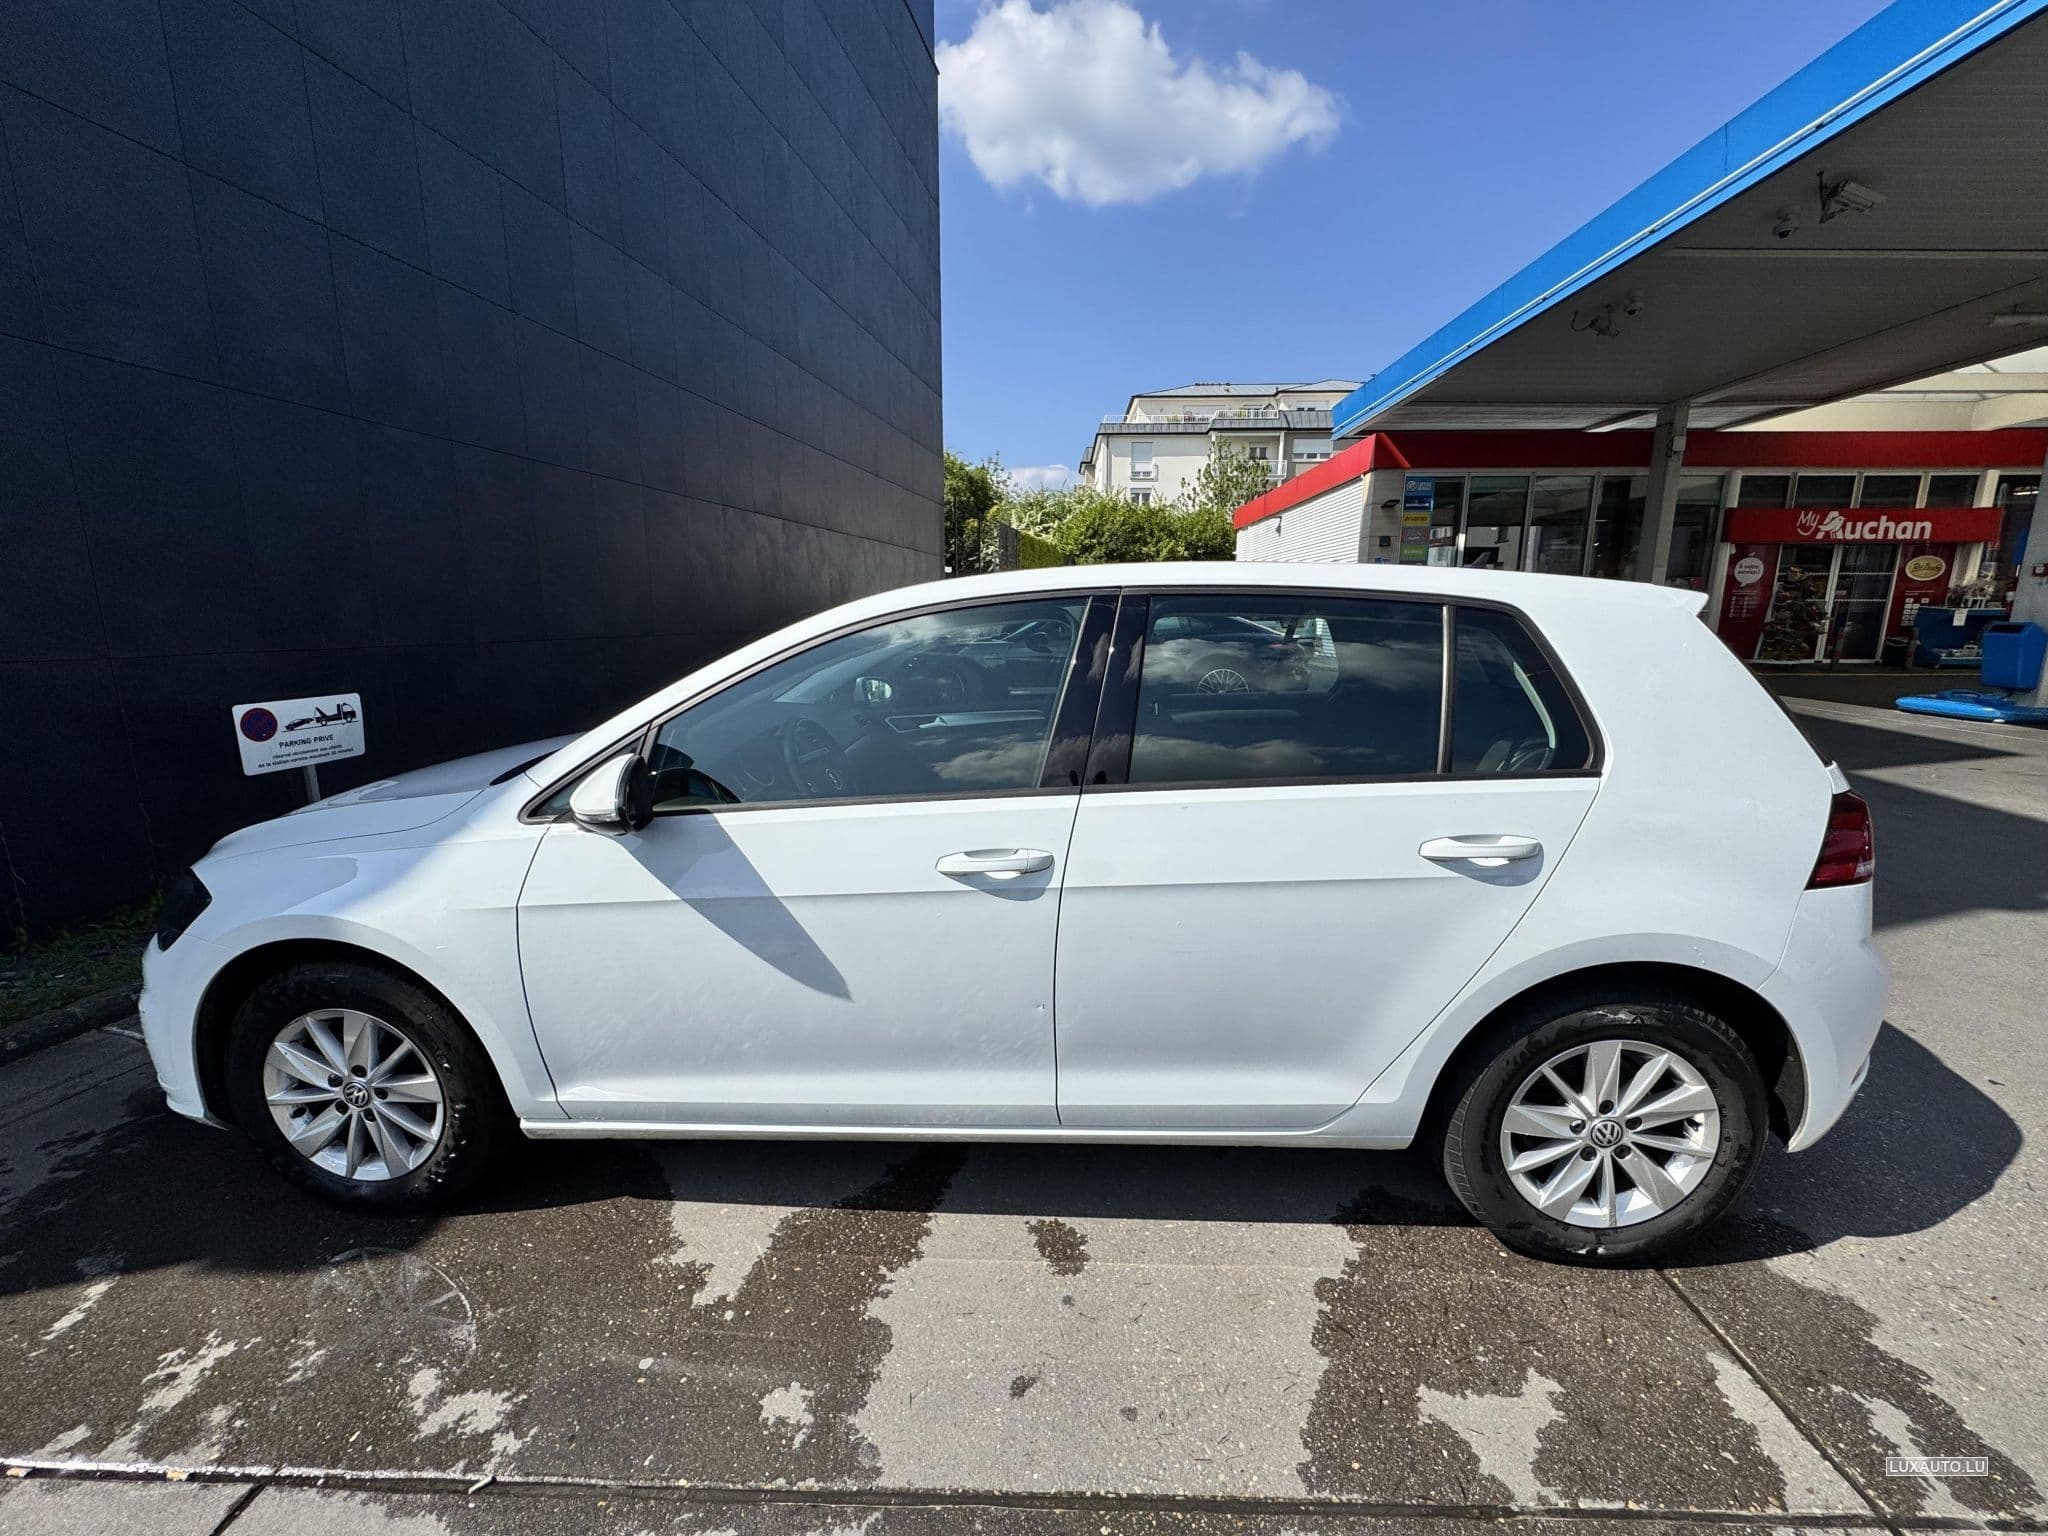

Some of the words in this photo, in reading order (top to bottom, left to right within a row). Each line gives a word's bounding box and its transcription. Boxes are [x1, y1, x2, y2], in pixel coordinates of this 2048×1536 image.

[1796, 510, 1820, 535] My
[1816, 510, 1932, 540] Auchan
[279, 738, 312, 748] PARKING
